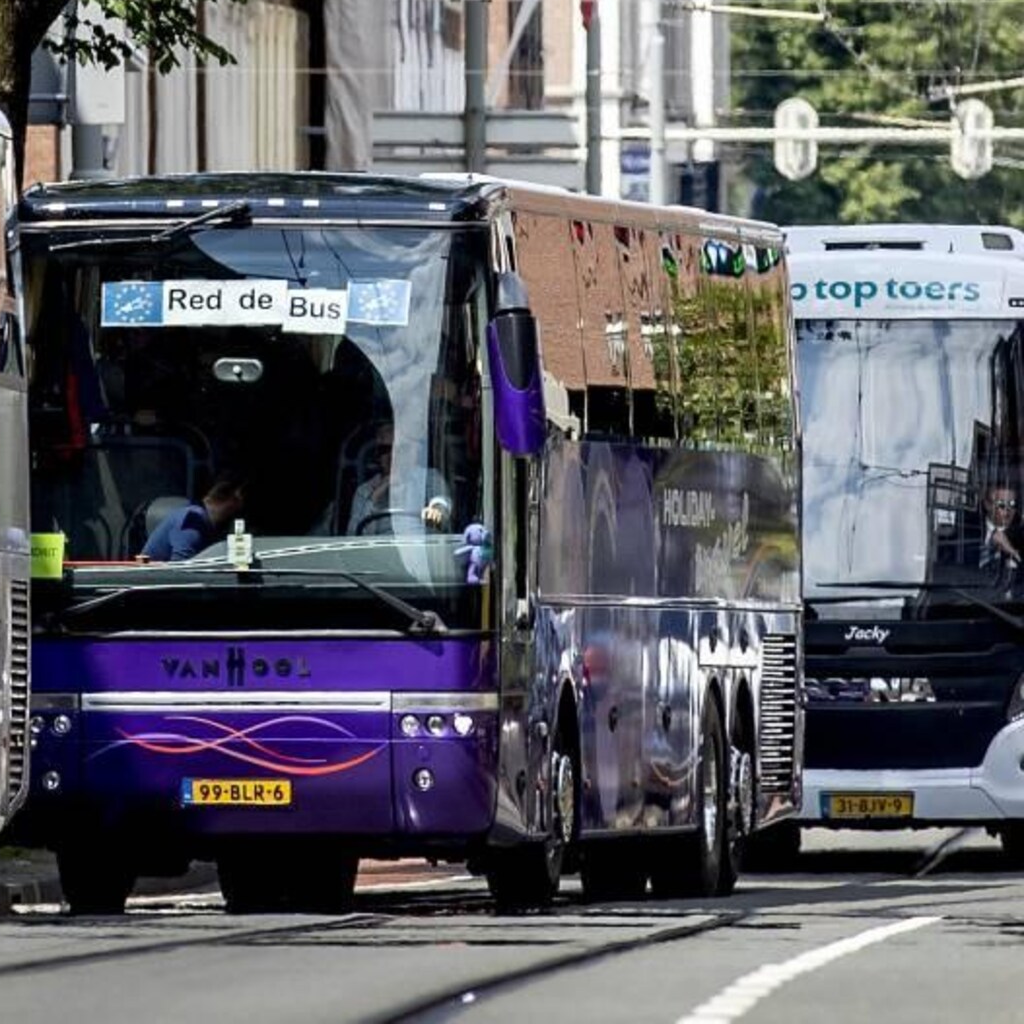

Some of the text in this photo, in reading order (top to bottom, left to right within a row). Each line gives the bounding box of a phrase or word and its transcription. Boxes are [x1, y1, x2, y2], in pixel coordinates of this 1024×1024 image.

[168, 288, 341, 320] Red de Bus
[814, 278, 878, 308] top
[886, 278, 980, 302] toers
[844, 625, 890, 644] Jacky
[199, 784, 285, 802] 99-BLR-6
